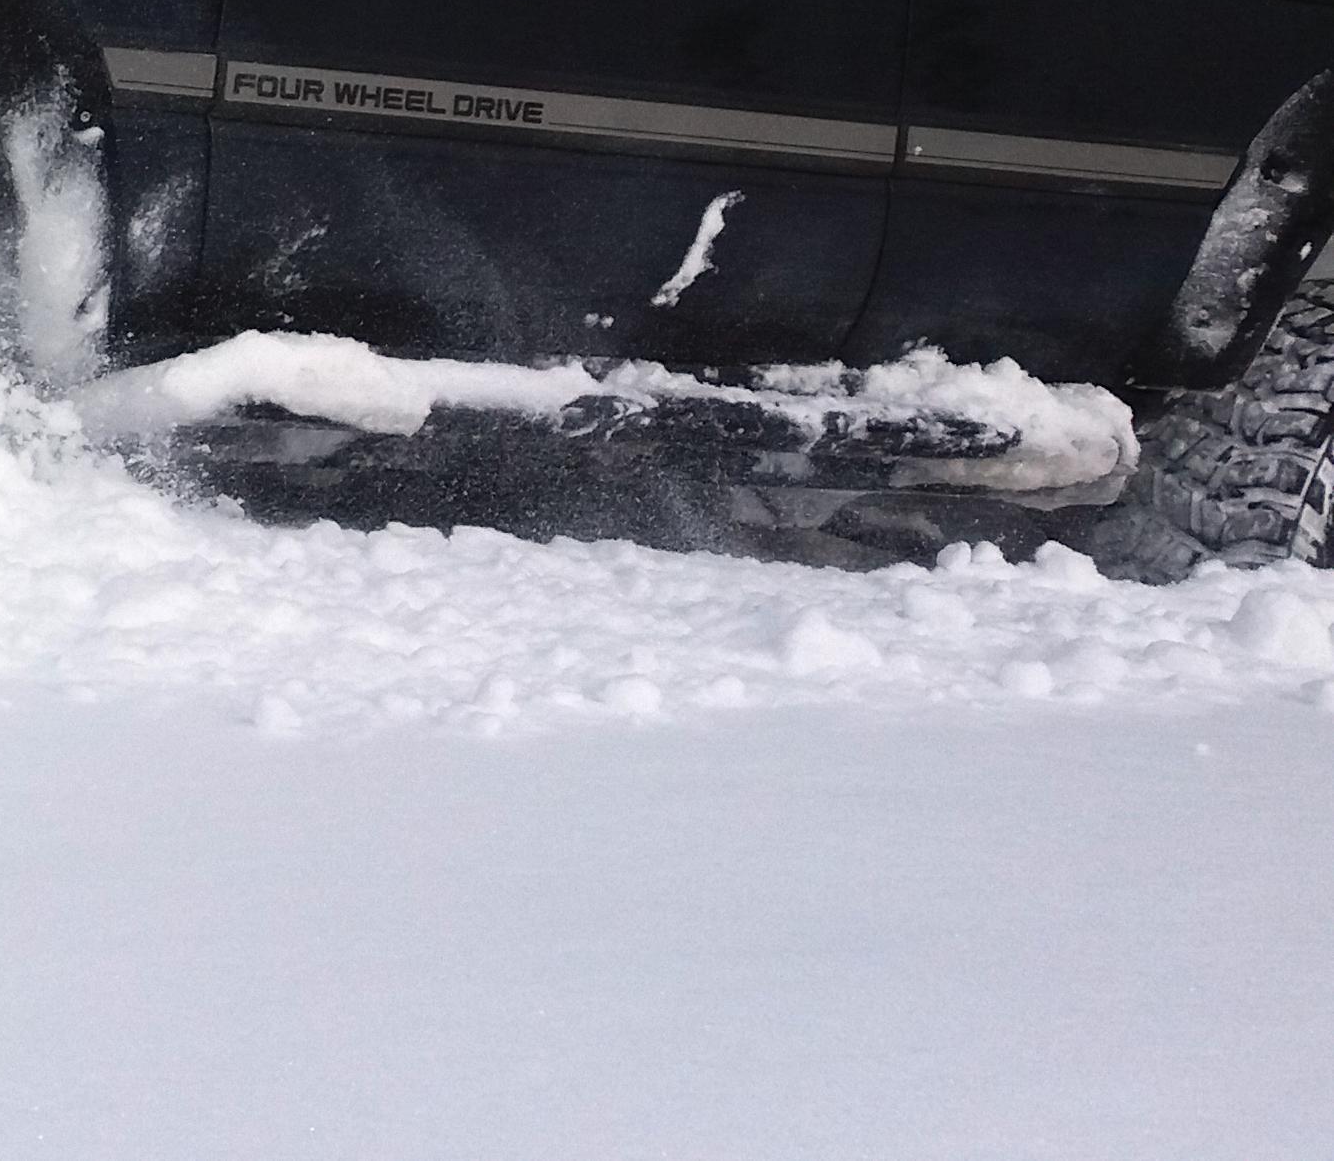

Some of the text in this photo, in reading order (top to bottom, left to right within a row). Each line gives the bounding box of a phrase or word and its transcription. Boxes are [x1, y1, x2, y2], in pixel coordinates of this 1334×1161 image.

[233, 73, 544, 124] FOUR WHEEL DRIVE
